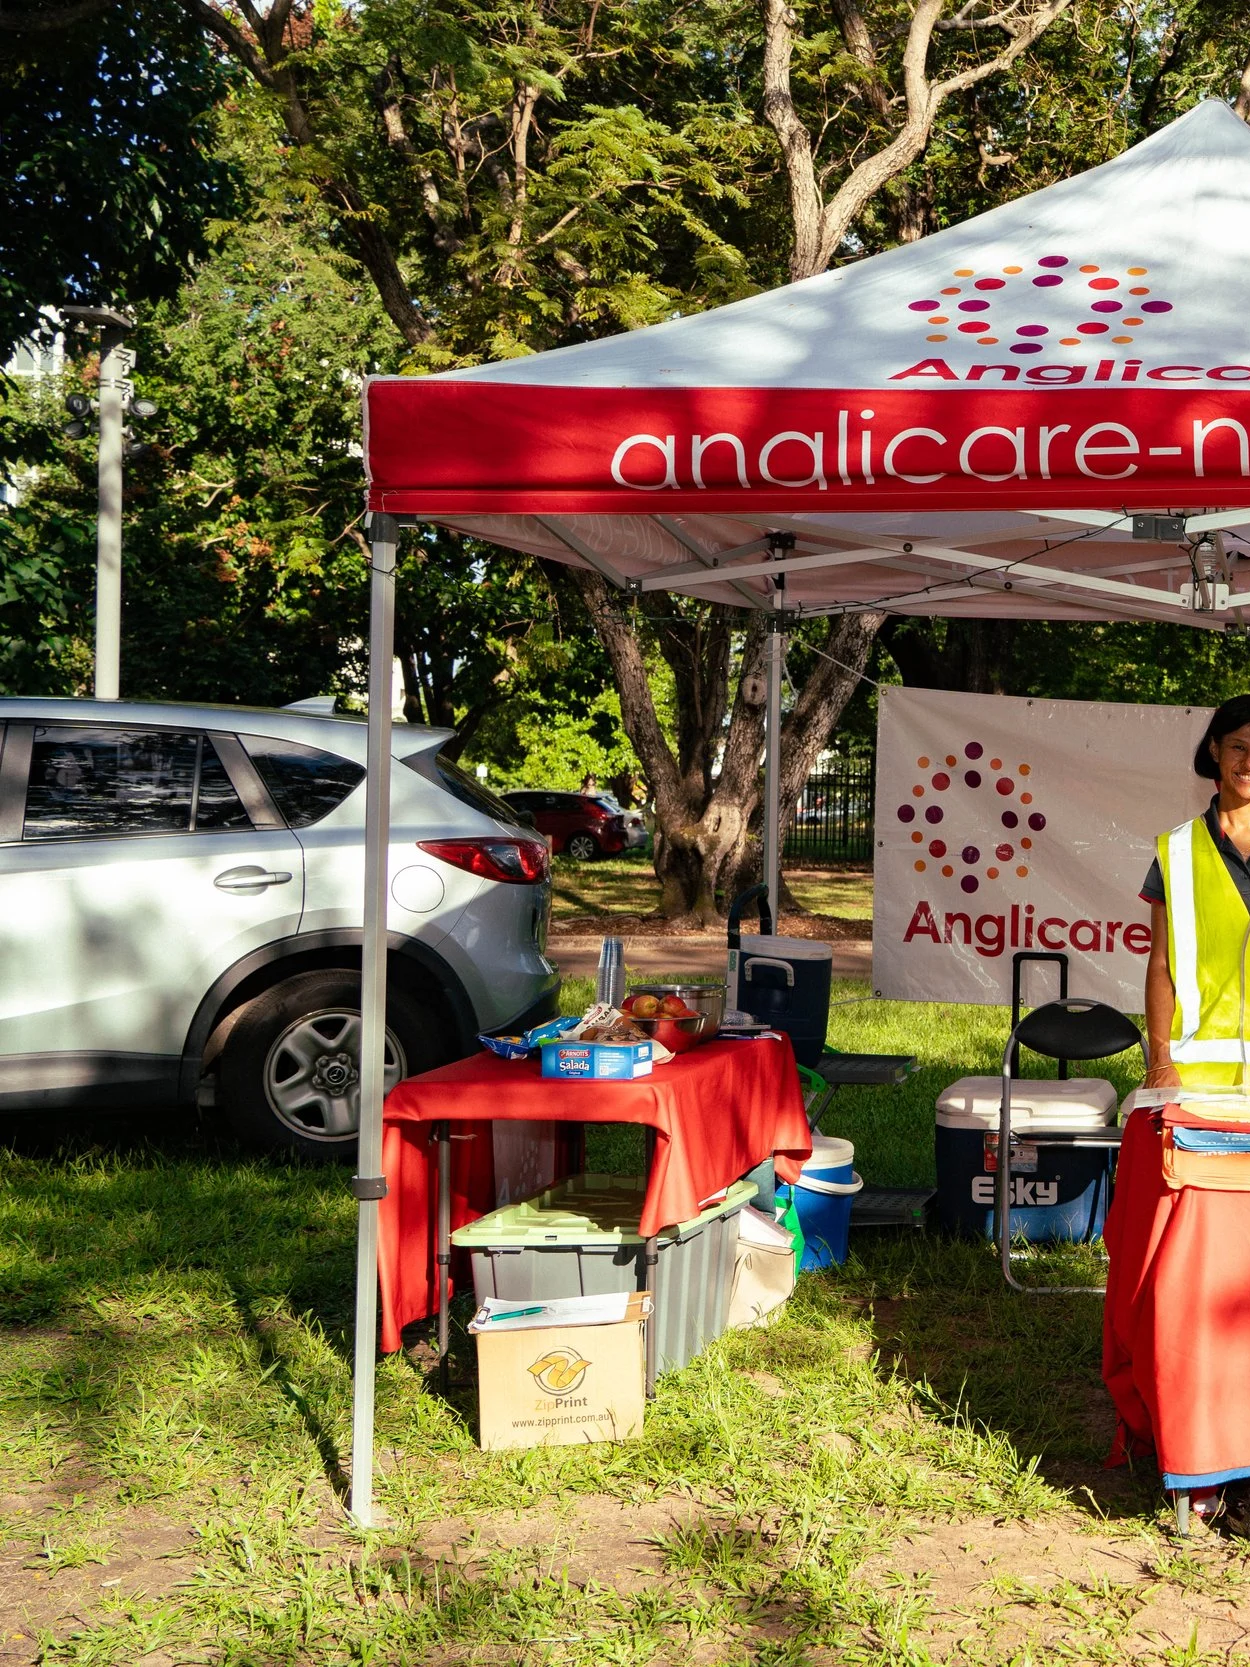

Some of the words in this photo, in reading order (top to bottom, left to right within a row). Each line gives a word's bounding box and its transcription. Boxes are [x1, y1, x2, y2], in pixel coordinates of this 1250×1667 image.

[903, 901, 1152, 957] Anglicare
[559, 1060, 590, 1071] Salada
[971, 1176, 1058, 1206] Eky
[511, 1413, 611, 1428] www.zipprint.com.au
